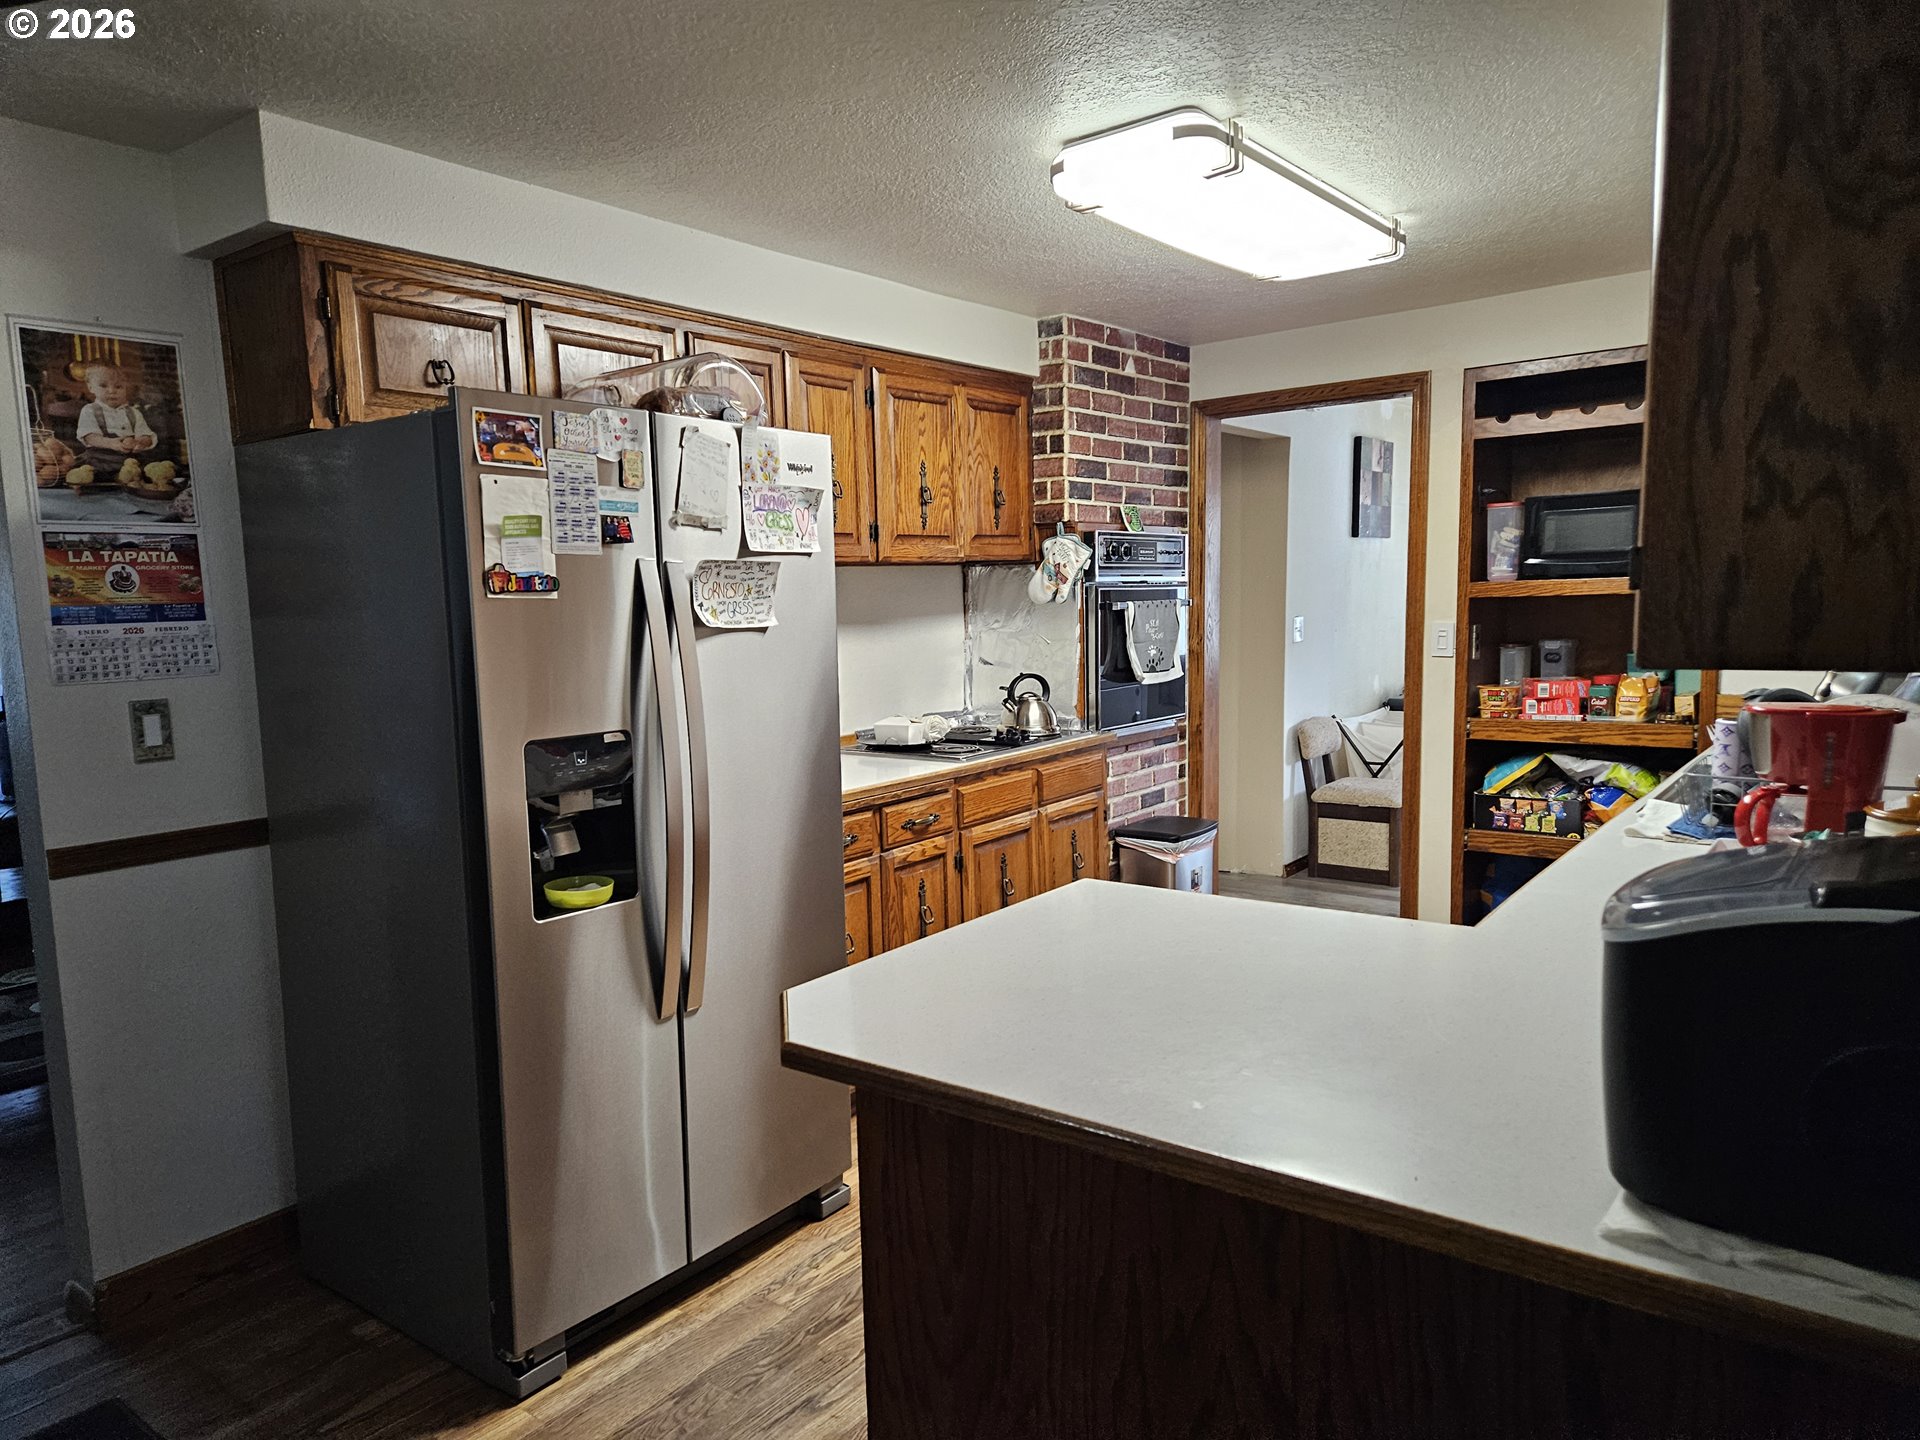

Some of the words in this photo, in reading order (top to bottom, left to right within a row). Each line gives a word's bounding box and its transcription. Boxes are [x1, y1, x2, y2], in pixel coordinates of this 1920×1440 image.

[67, 551, 94, 562] LA
[100, 551, 179, 563] TAPATIA
[701, 580, 745, 600] ERNESTO
[727, 601, 754, 619] GRESS
[122, 627, 145, 635] 2026
